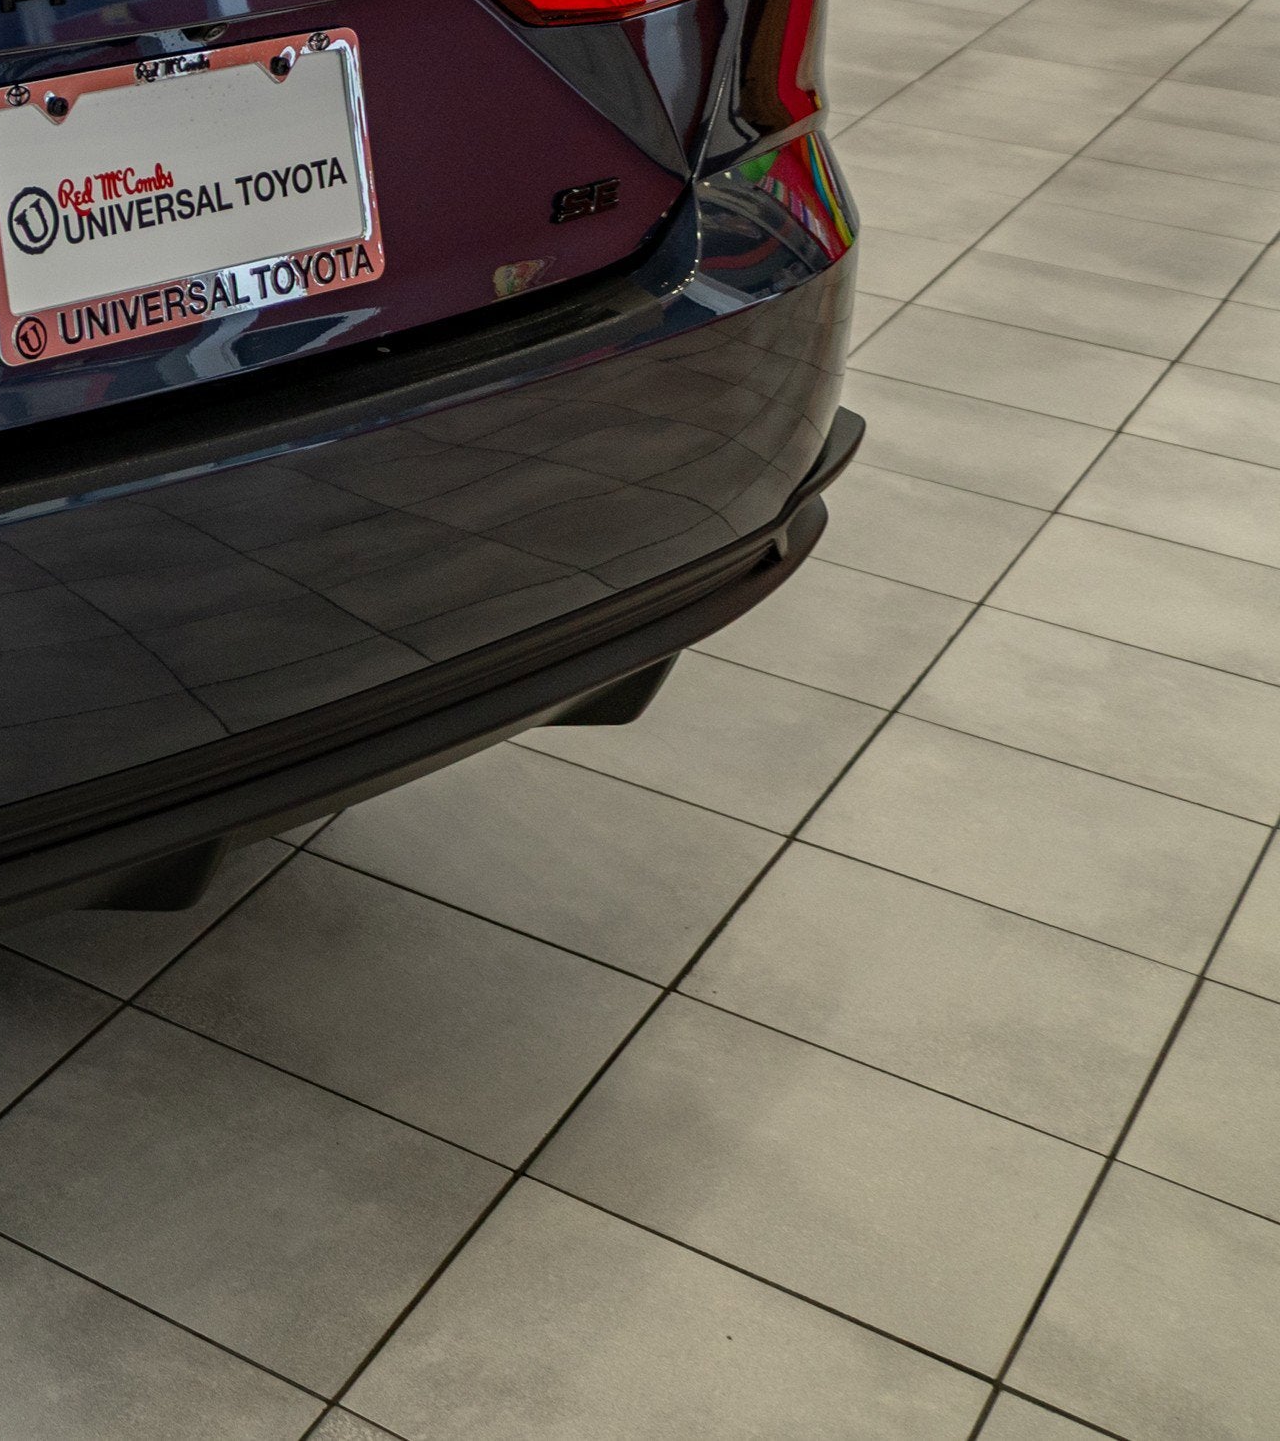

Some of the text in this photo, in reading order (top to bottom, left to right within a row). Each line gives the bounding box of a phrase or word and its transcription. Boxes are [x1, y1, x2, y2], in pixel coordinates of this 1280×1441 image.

[58, 178, 94, 216] Red
[62, 180, 234, 245] UNIVERSAL
[235, 156, 348, 208] TOYOTA
[550, 176, 621, 224] SE
[57, 271, 251, 346] UNIVERSAL
[251, 243, 375, 301] TOYOTA
